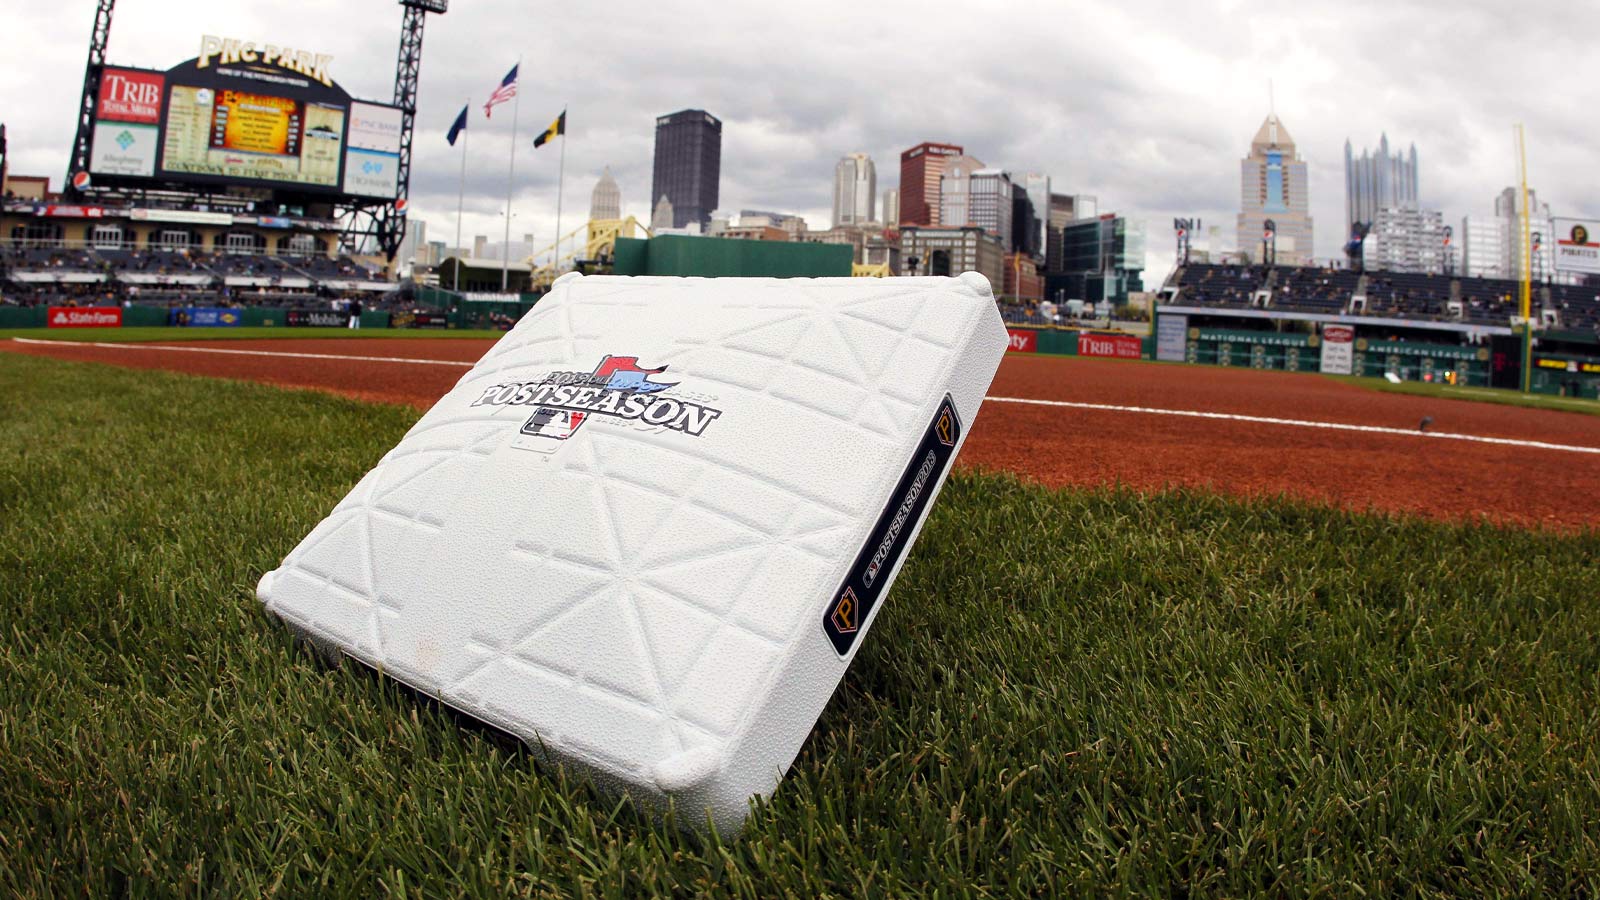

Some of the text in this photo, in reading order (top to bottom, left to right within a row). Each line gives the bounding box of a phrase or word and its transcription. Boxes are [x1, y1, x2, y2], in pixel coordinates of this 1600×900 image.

[197, 35, 335, 88] PNC PARK
[105, 74, 159, 105] TRIB
[1078, 337, 1114, 355] TRIB
[1200, 333, 1306, 347] NATIONAL LEAGUE
[1369, 345, 1476, 360] AMERICAN LEAGUE
[470, 382, 723, 437] POSTSEASON
